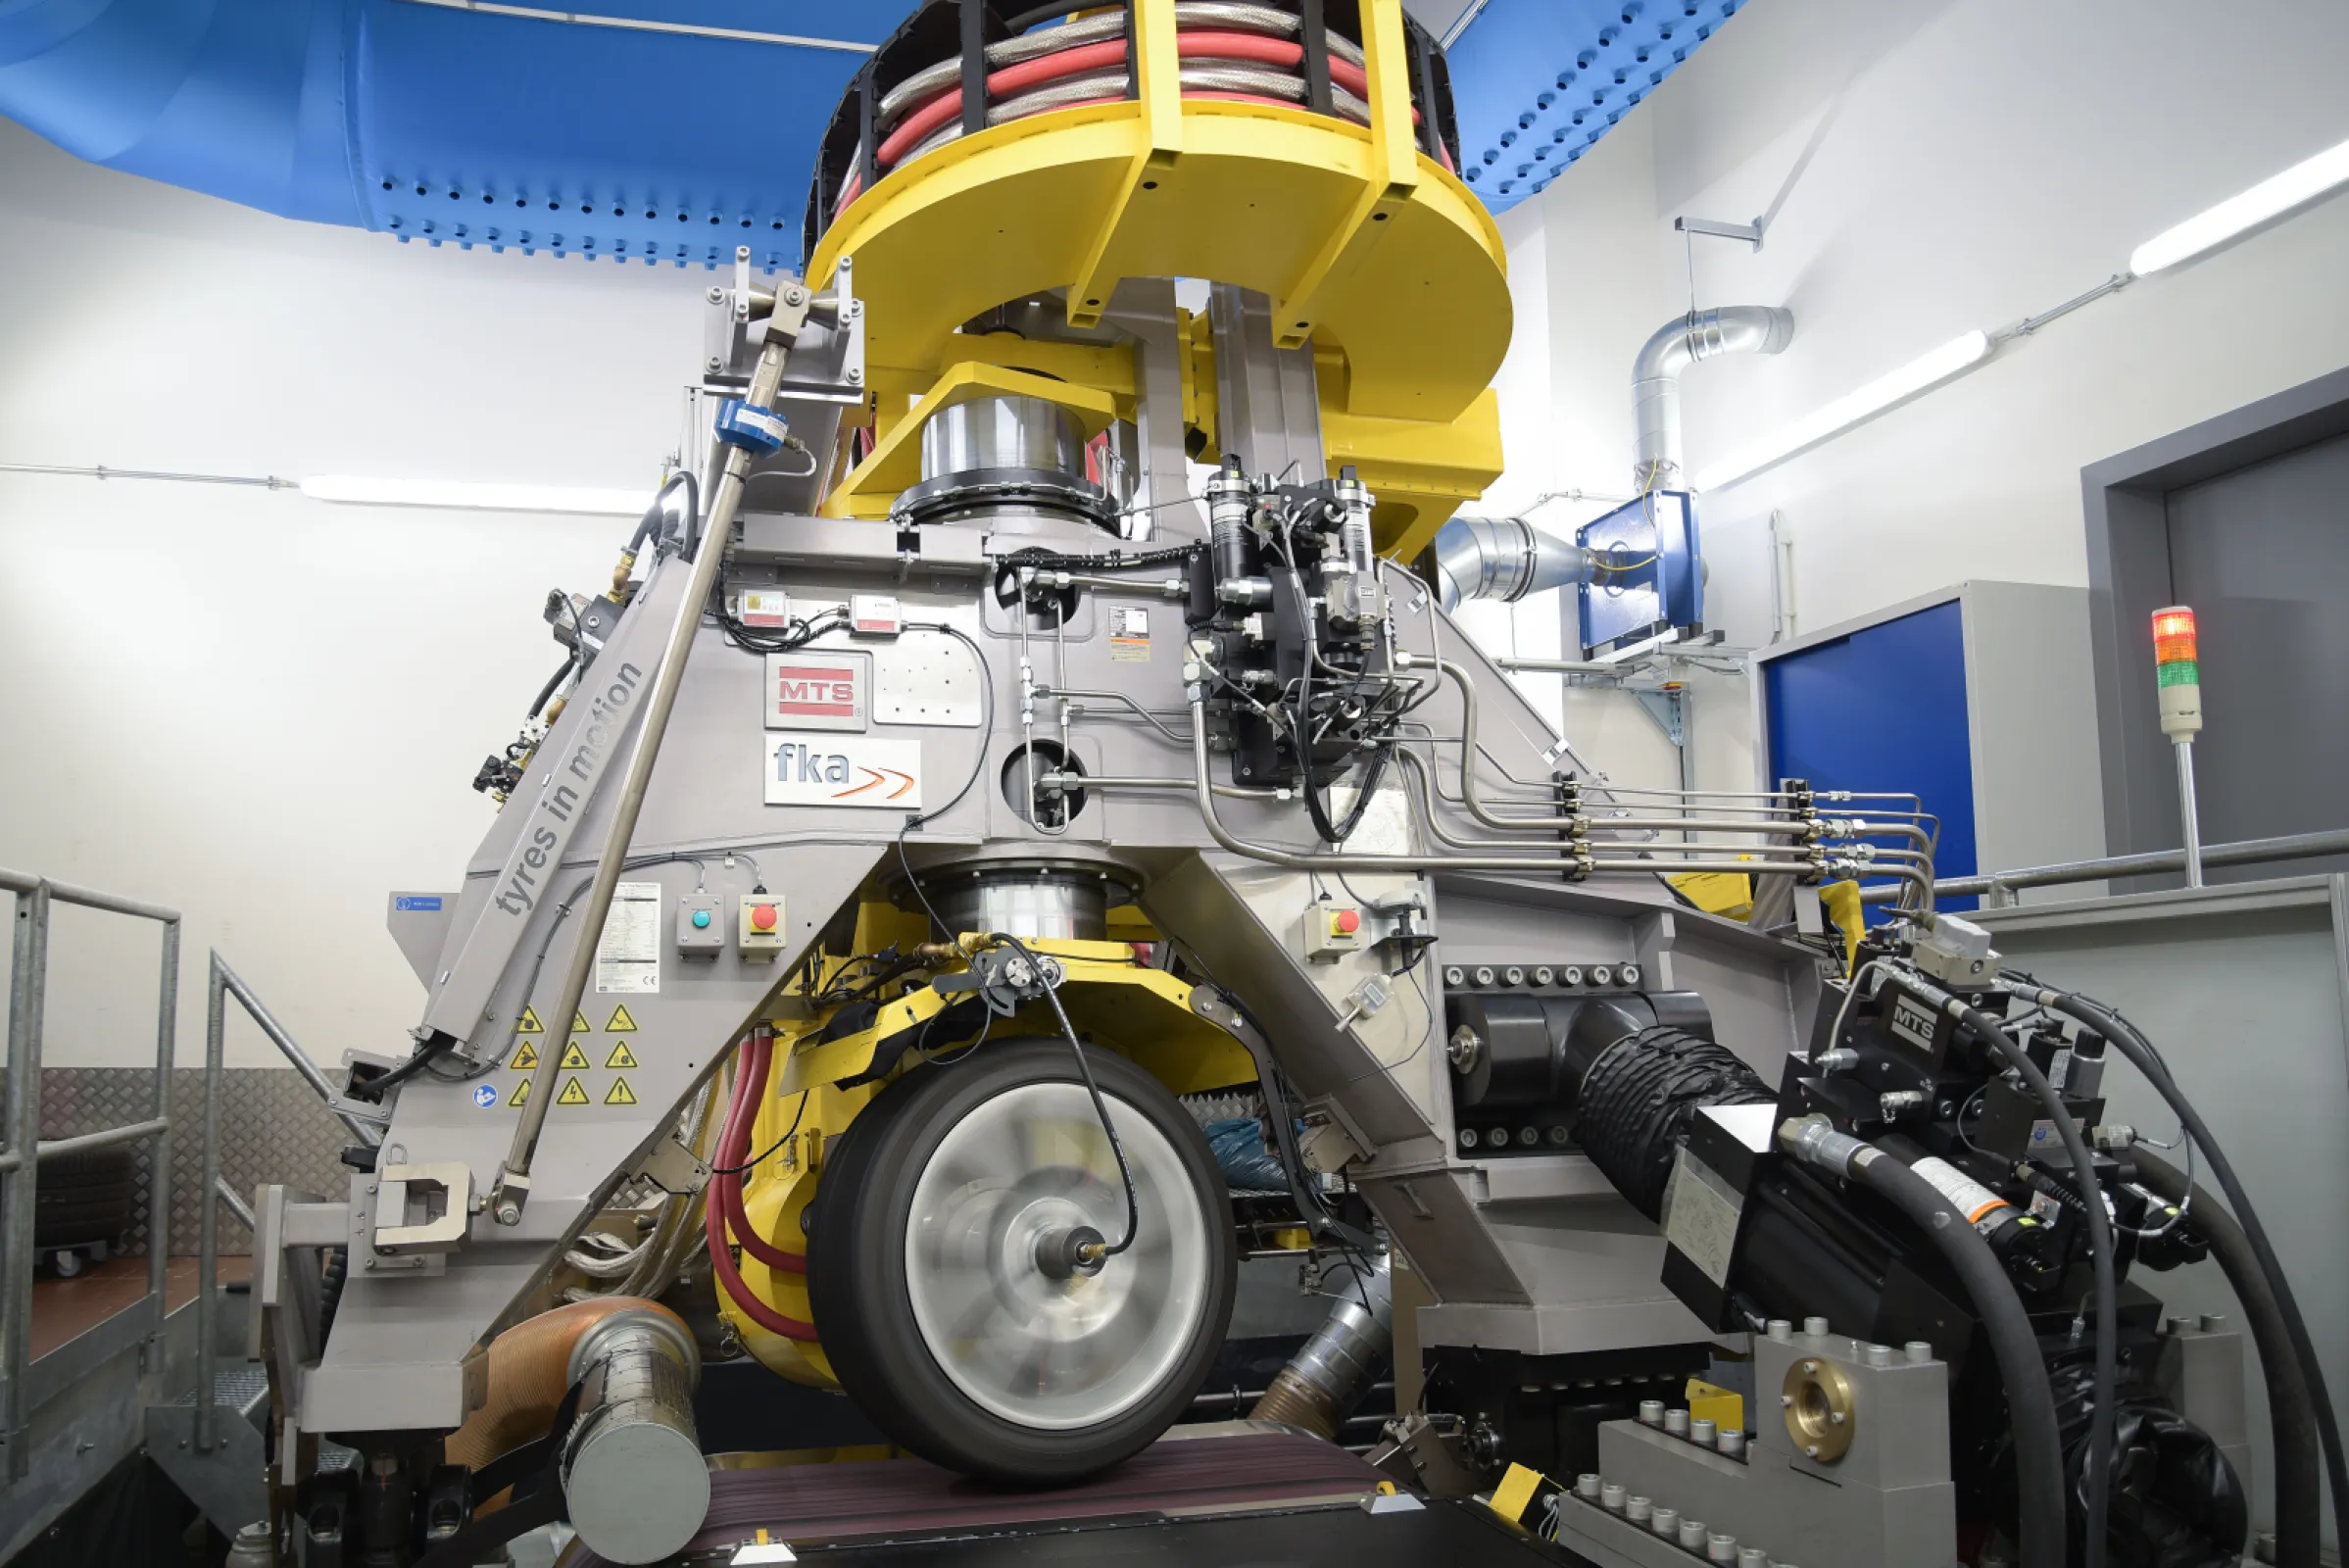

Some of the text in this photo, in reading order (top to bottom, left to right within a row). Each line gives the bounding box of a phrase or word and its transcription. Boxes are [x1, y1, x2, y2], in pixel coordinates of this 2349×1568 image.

[779, 681, 854, 702] MTS
[773, 743, 850, 784] fka
[496, 662, 643, 916] tyres in motion
[1894, 1005, 1934, 1039] MTS
